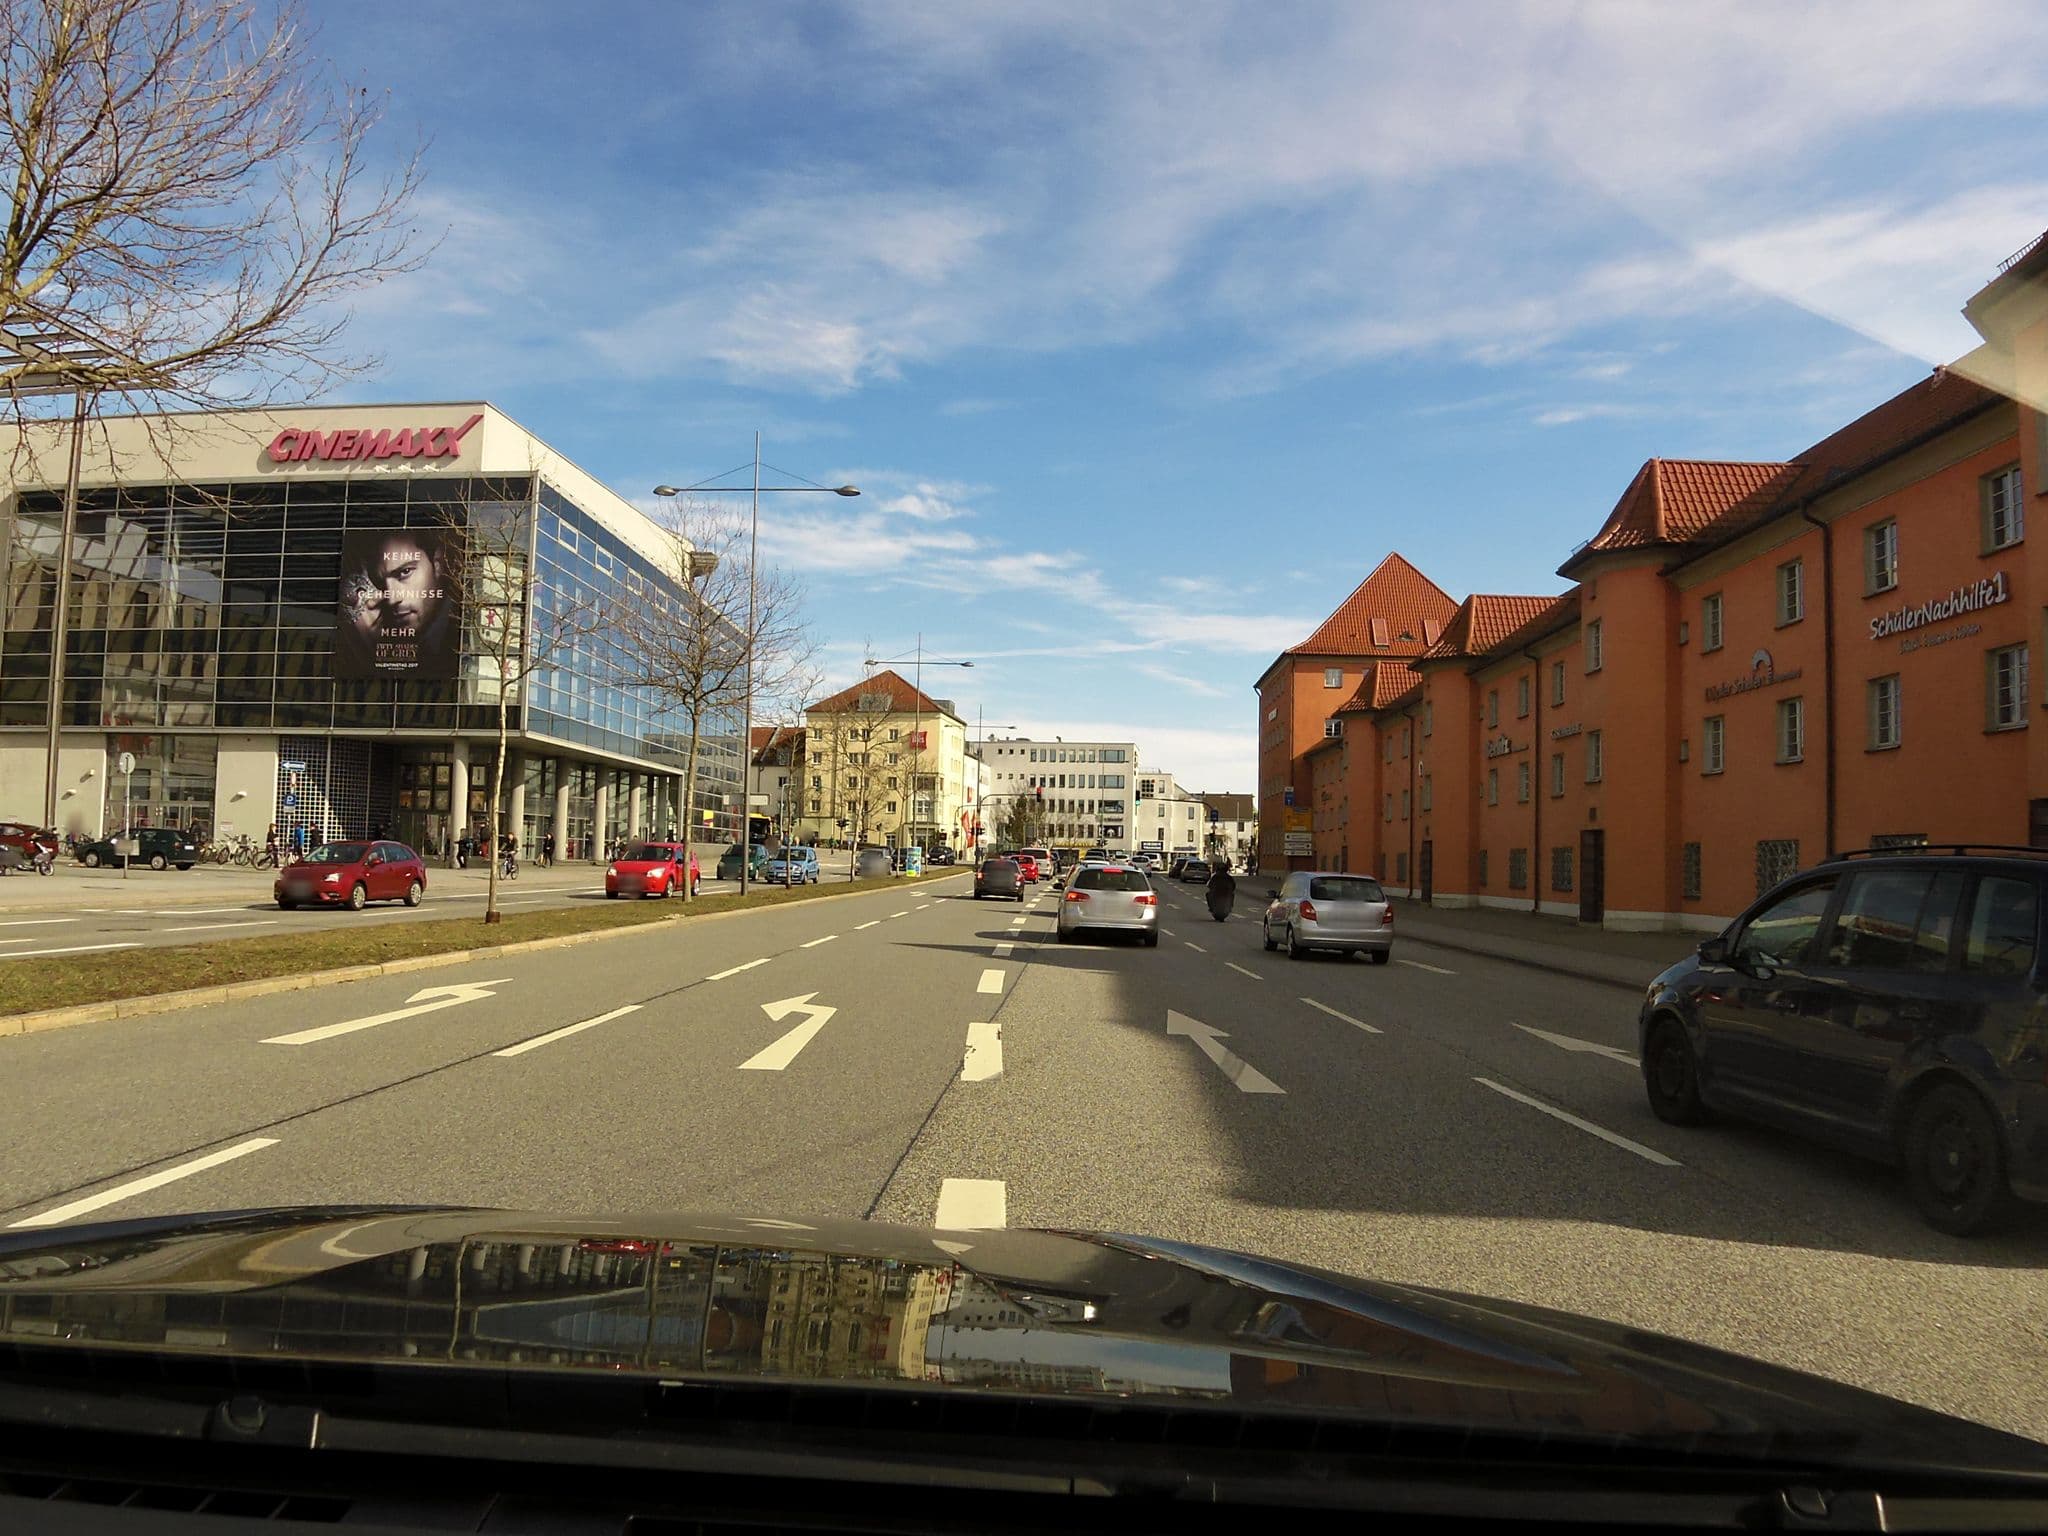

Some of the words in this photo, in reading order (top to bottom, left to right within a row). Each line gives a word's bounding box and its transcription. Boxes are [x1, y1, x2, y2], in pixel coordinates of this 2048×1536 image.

[266, 414, 484, 461] CINEMAXX
[382, 552, 421, 561] KEINE
[357, 589, 444, 599] GEHEIMNISSE
[1869, 571, 2007, 640] SchülerNachhilfe1
[381, 628, 416, 637] MEHR
